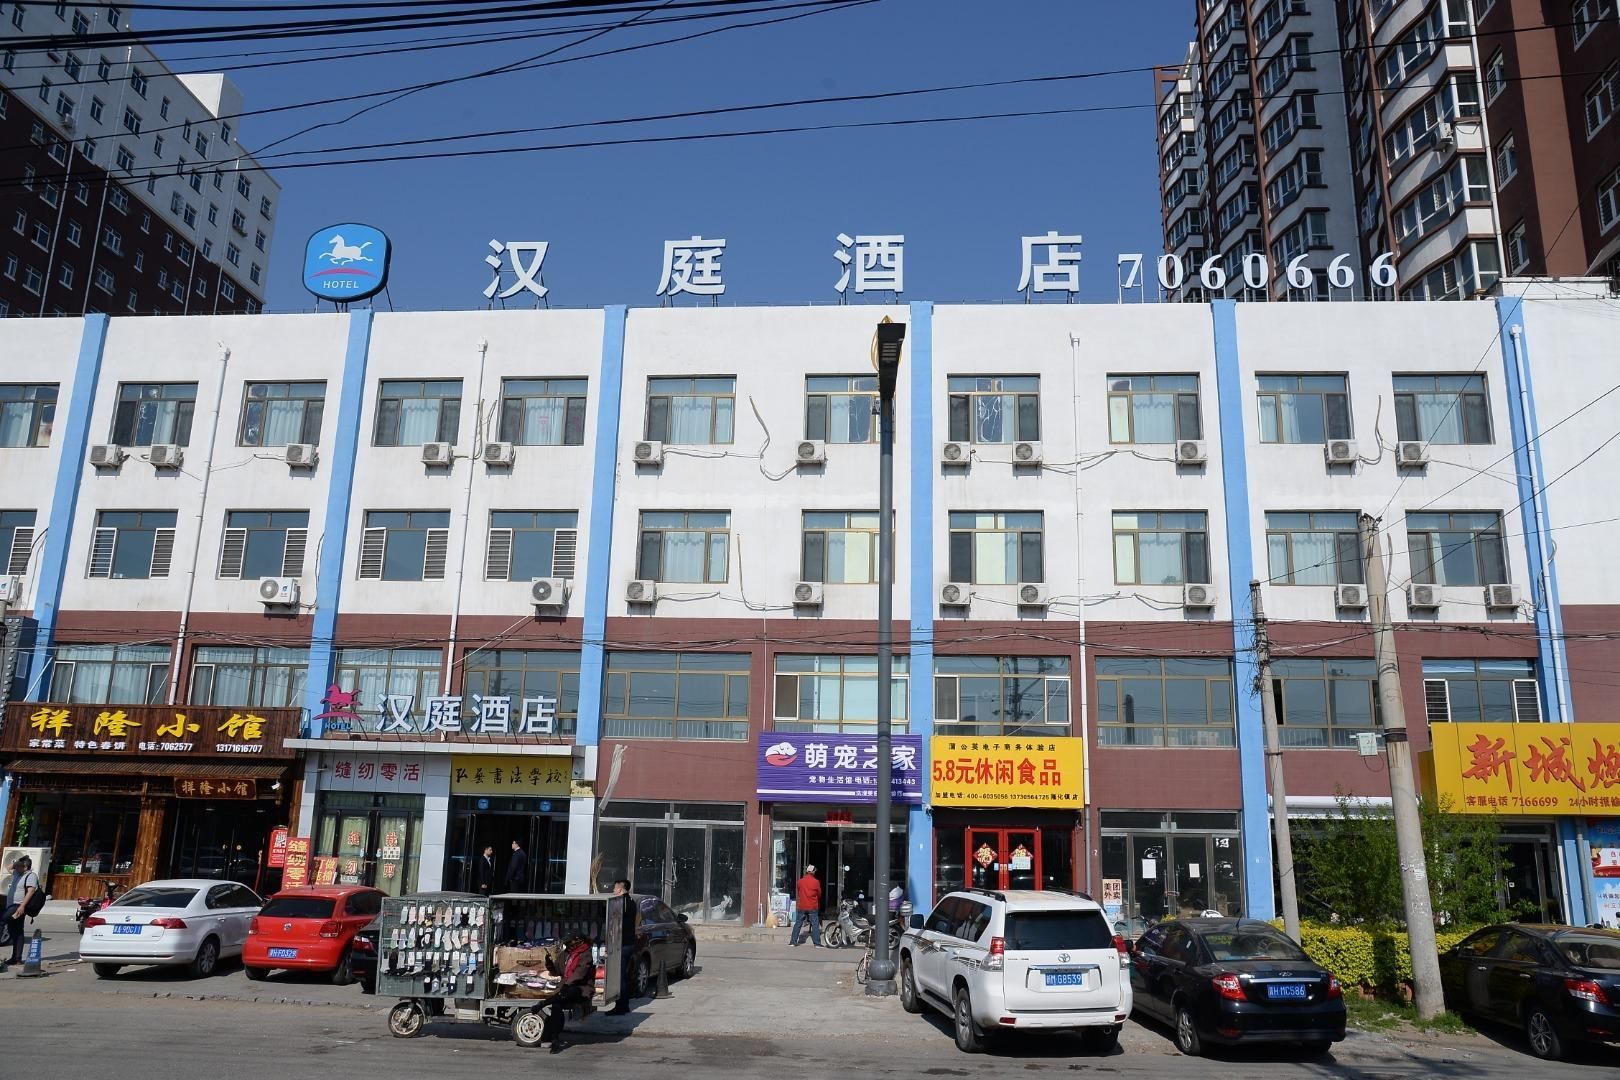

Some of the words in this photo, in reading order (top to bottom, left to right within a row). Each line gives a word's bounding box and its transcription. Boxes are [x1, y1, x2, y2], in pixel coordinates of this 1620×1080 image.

[483, 231, 1082, 298] 汉庭酒店
[1118, 253, 1399, 291] 7060666
[323, 280, 360, 290] HOTEL
[376, 692, 558, 735] 汉庭酒店
[30, 707, 267, 741] 祥隆小馆
[324, 721, 352, 731] HOTEL
[28, 738, 66, 749] 家常菜
[804, 743, 916, 771] 萌宠之家
[334, 761, 420, 781] 缝纫零活
[932, 757, 1061, 786] 5.8元休闲食品
[182, 780, 249, 796] 祥隆小馆
[1466, 795, 1508, 807] 客服电话
[1511, 796, 1558, 807] 7166699
[1104, 882, 1121, 891] 美团
